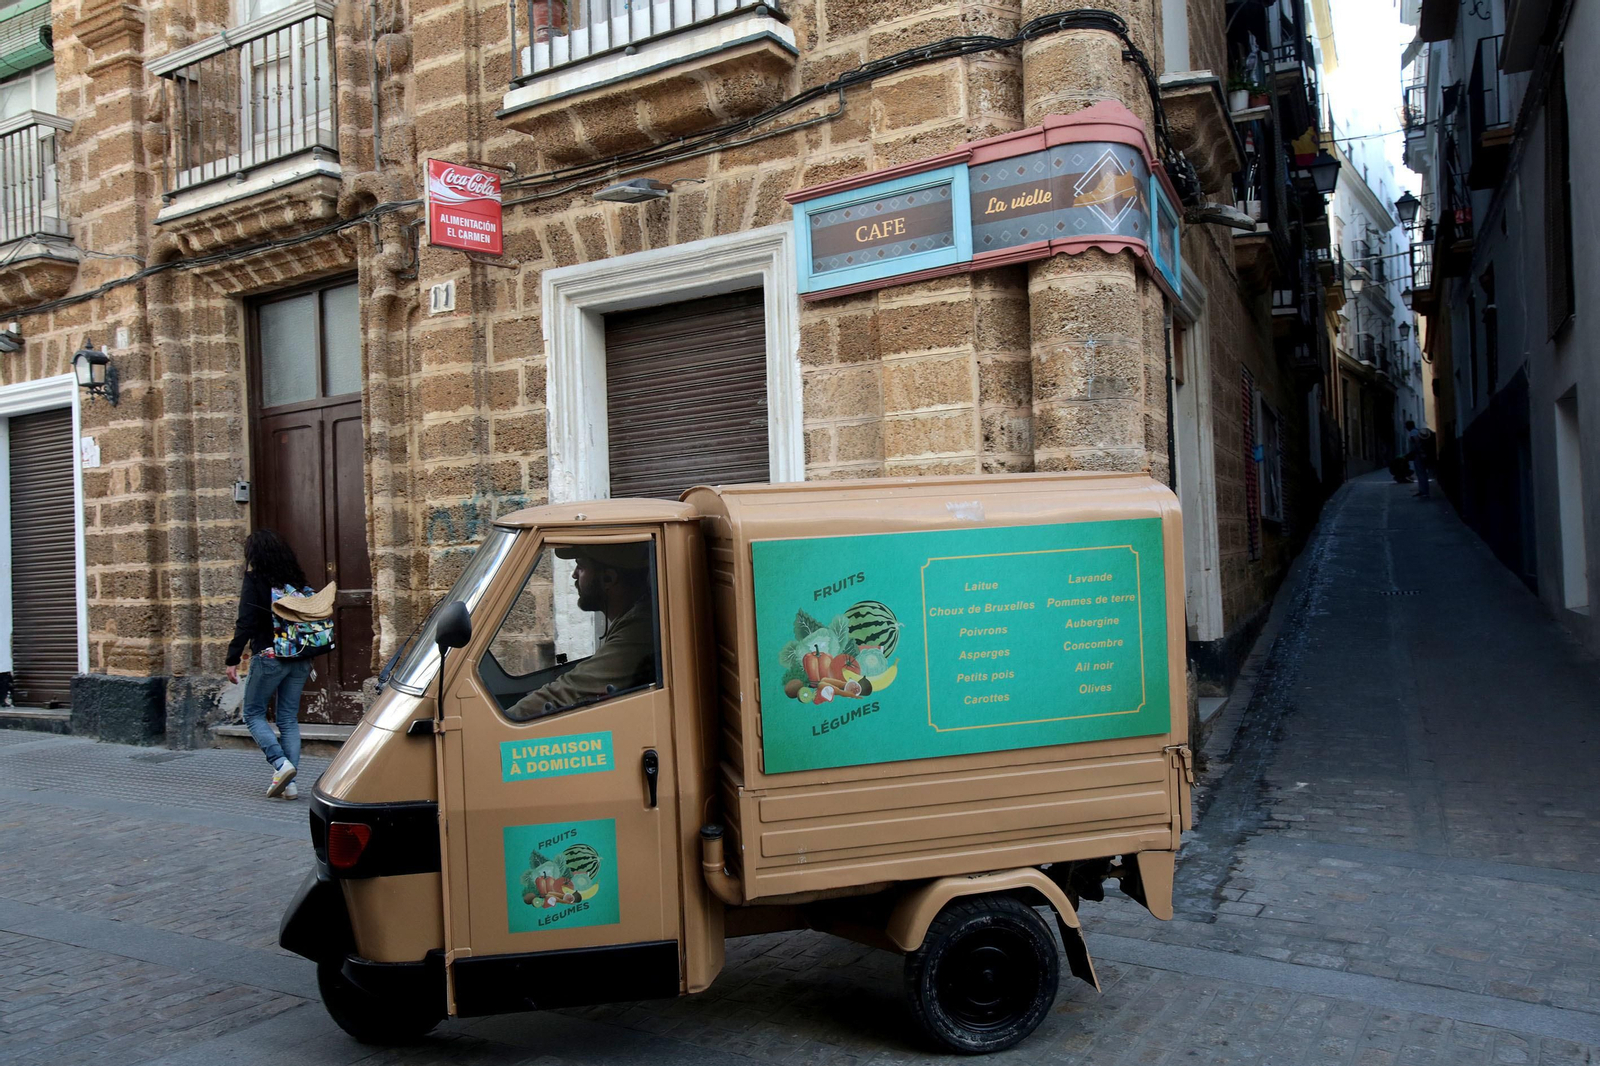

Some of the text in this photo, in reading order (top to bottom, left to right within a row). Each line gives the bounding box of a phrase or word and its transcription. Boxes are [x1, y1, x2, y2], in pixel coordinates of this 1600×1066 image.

[440, 167, 500, 197] Coca-Cola
[984, 188, 1053, 215] La vielle
[440, 213, 497, 233] ALIMENTACIÓN
[855, 217, 906, 243] CAFE
[447, 227, 491, 244] EL CARMEN
[433, 283, 452, 310] 11
[813, 572, 865, 601] FRUITS
[964, 581, 999, 592] Laitue
[1068, 573, 1113, 584] Lavande
[929, 601, 1035, 617] Choux de Bruxelles
[1046, 594, 1136, 608] Pommes de terre
[1065, 616, 1120, 628] Aubergine
[959, 626, 1008, 637] Poivrons
[1063, 639, 1124, 651] Concombre
[958, 649, 1010, 661] Asperges
[1075, 661, 1114, 673] Ail noir
[957, 670, 1015, 683] Petits pois
[1079, 684, 1112, 694] Olives
[964, 693, 1010, 705] Carottes
[812, 701, 880, 736] LÉGUMES
[512, 739, 602, 760] LIVRAISON
[510, 754, 607, 775] À DOMICILE
[538, 828, 578, 850] FRUITS
[538, 902, 590, 926] LÉGUMES
